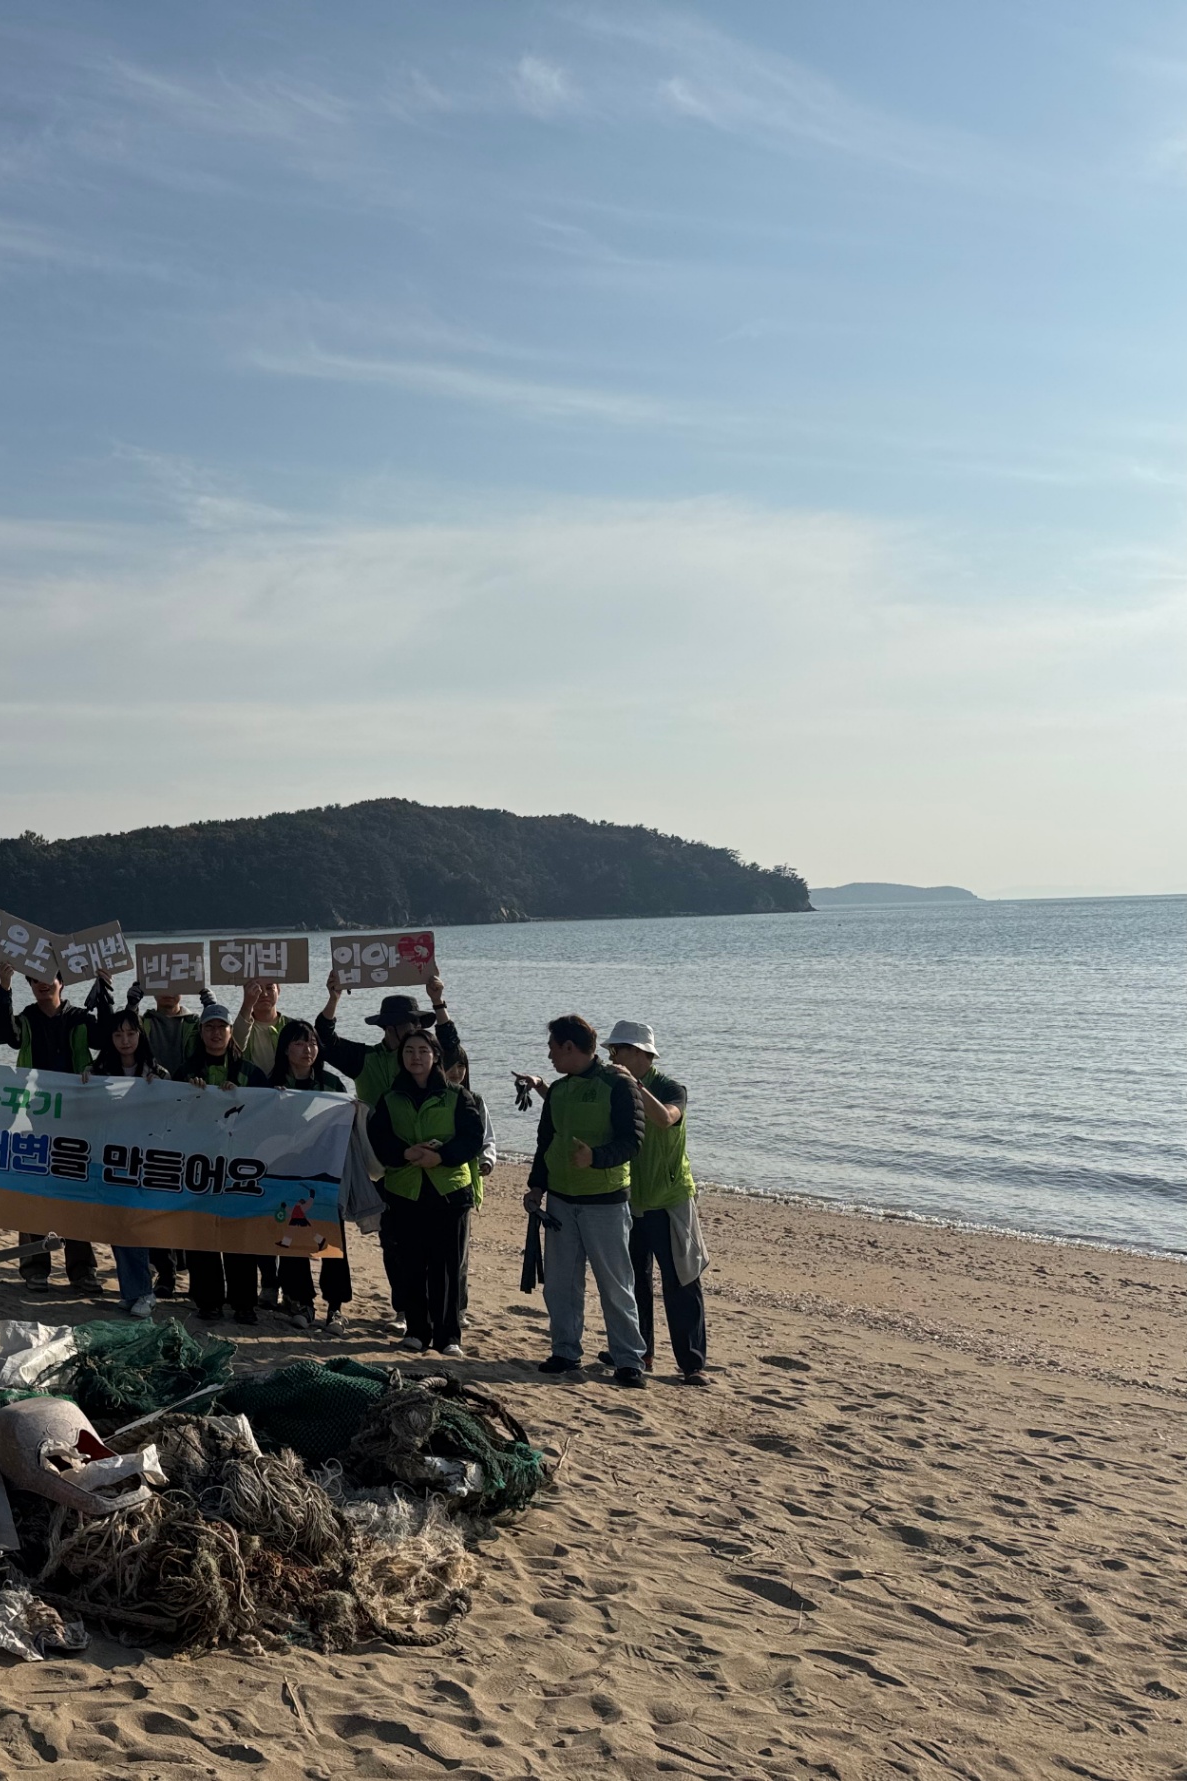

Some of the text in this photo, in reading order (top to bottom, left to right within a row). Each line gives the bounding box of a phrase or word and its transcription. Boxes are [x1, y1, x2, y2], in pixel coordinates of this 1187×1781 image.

[60, 933, 128, 977] 해변
[142, 953, 204, 989] 반려
[218, 941, 288, 979] 해변
[333, 942, 400, 984] 입양
[102, 1143, 268, 1197] 만들어요
